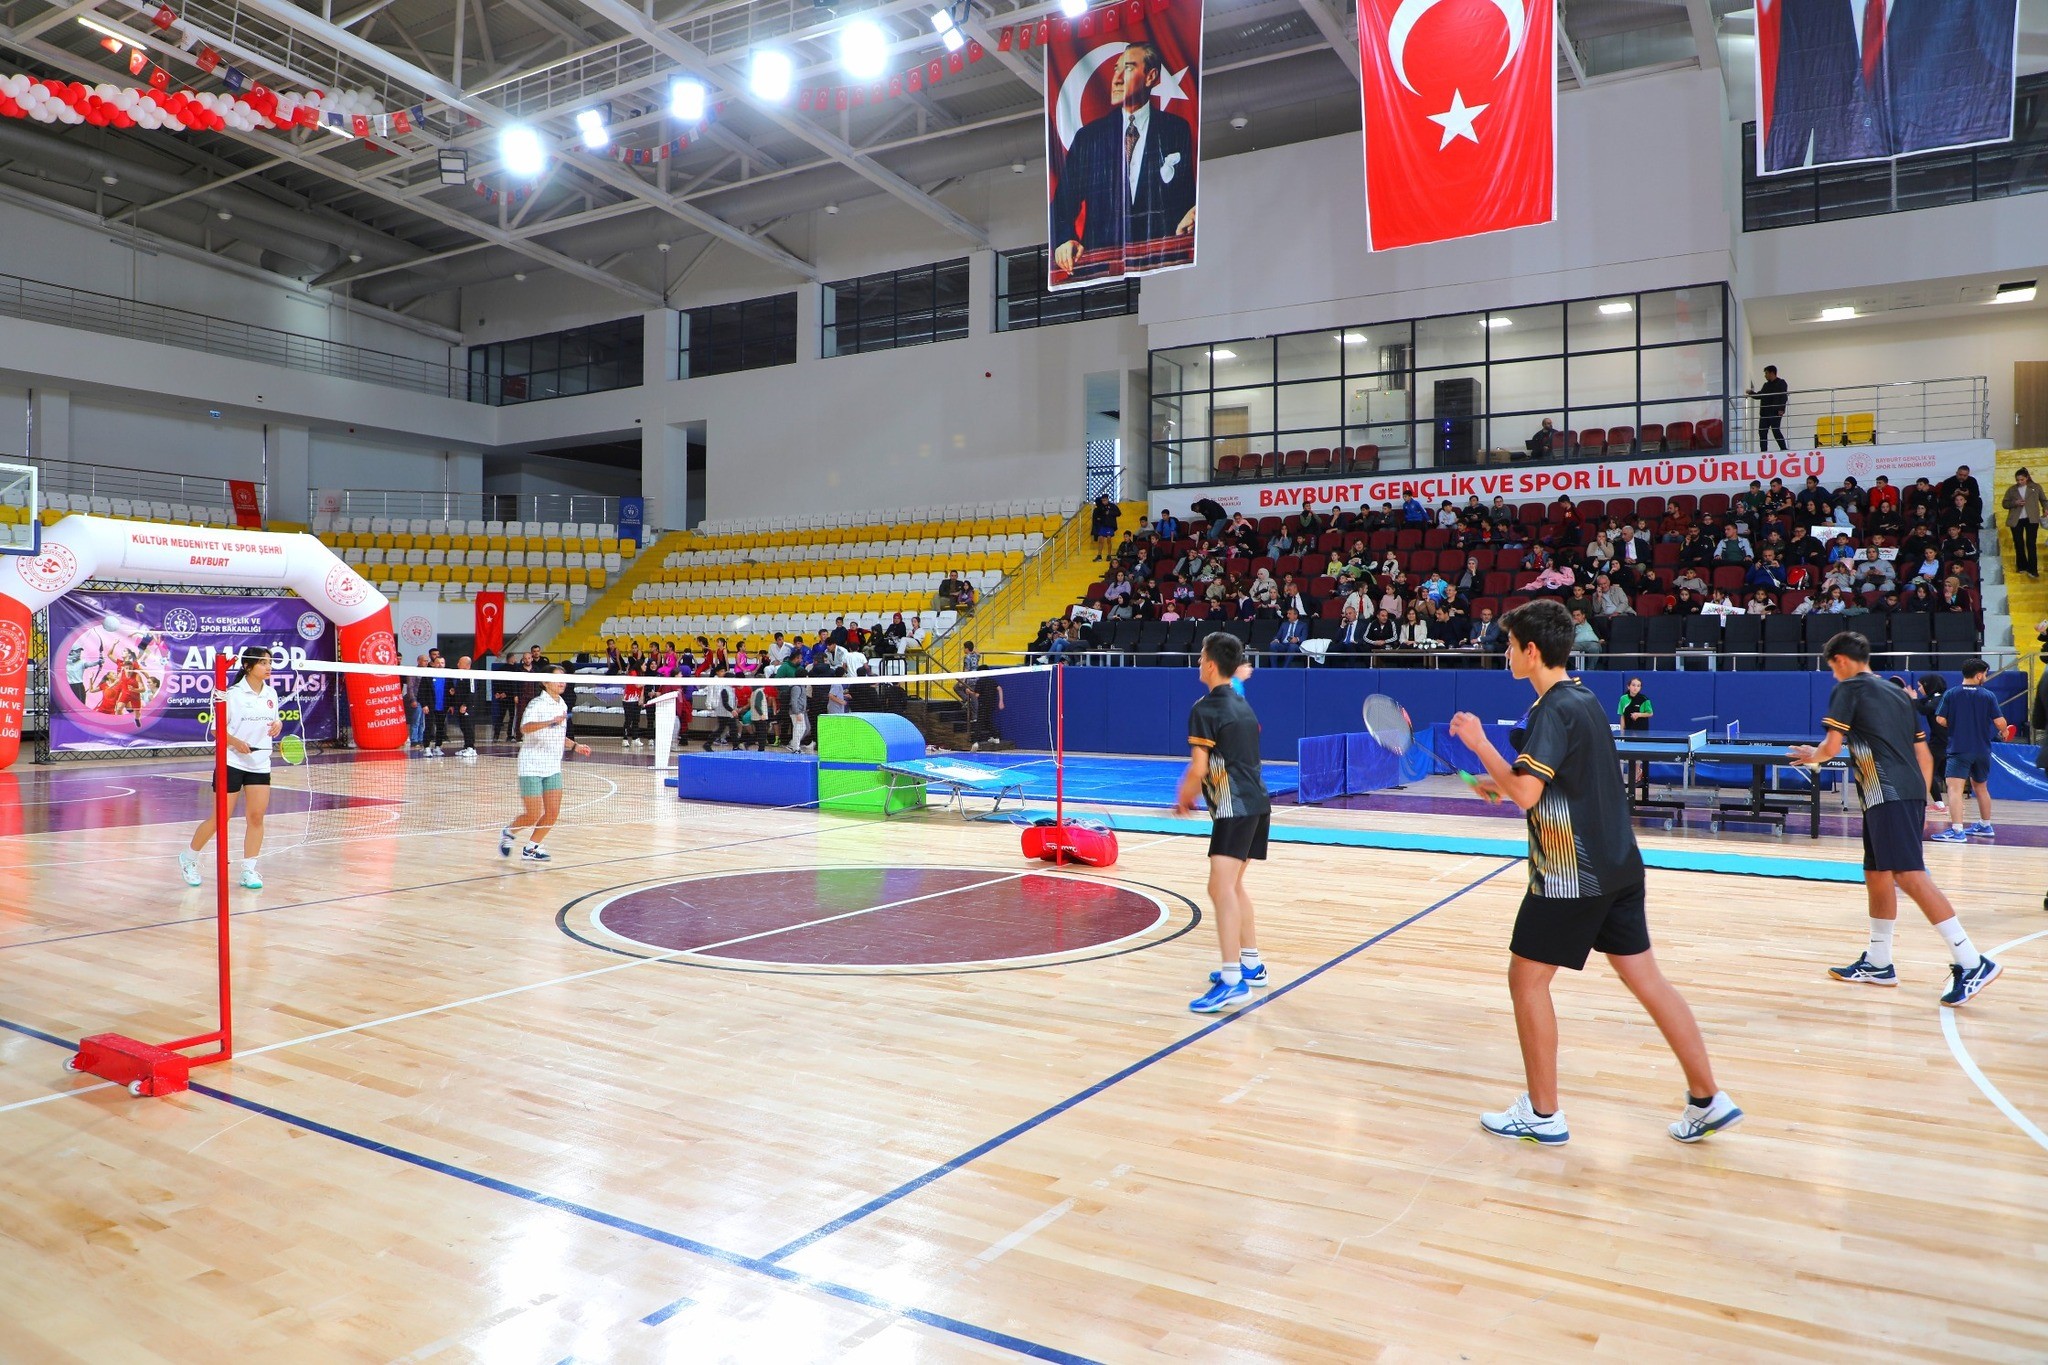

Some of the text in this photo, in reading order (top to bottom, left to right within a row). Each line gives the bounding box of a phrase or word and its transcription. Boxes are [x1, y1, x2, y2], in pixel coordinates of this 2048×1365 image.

[1259, 451, 1826, 508] BAYBURT GENÇLİK VE SPOR İL MÜDÜRLÜĞÜ
[132, 534, 283, 556] KÜLTÜR MEDENİYET VE SPOR ŞEHRİ
[190, 556, 230, 567] BAYBURT
[200, 616, 261, 626] T.C. GENÇLİK VE
[200, 624, 261, 633] SPOR BAKANLIĞI
[11, 701, 21, 711] VE
[375, 706, 397, 716] SPOR
[5, 713, 14, 724] İL
